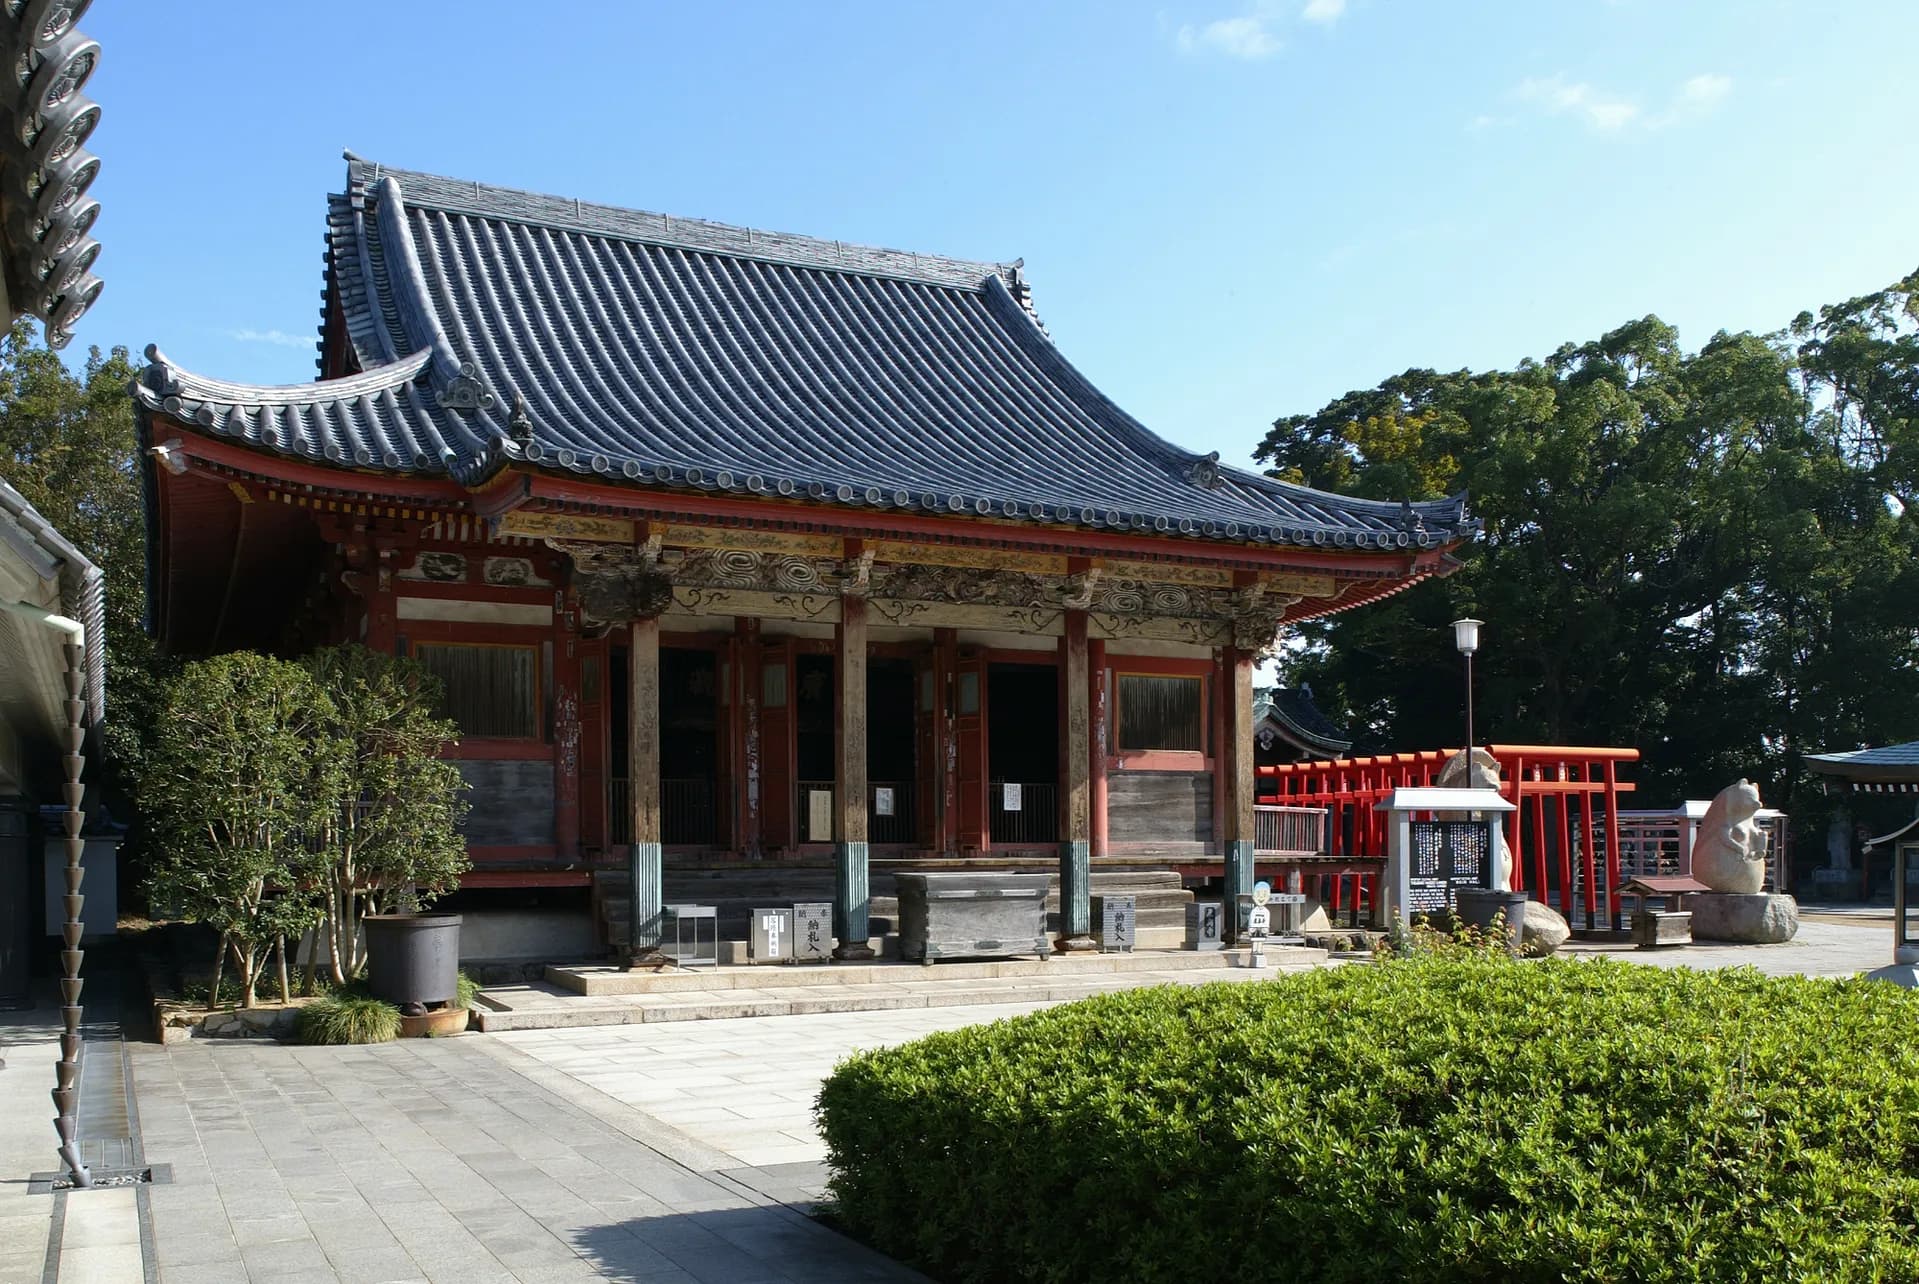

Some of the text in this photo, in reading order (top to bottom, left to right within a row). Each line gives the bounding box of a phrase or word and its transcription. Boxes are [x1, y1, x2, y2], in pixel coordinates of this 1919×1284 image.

[808, 920, 820, 952] 納札入
[1114, 911, 1125, 941] 納札入
